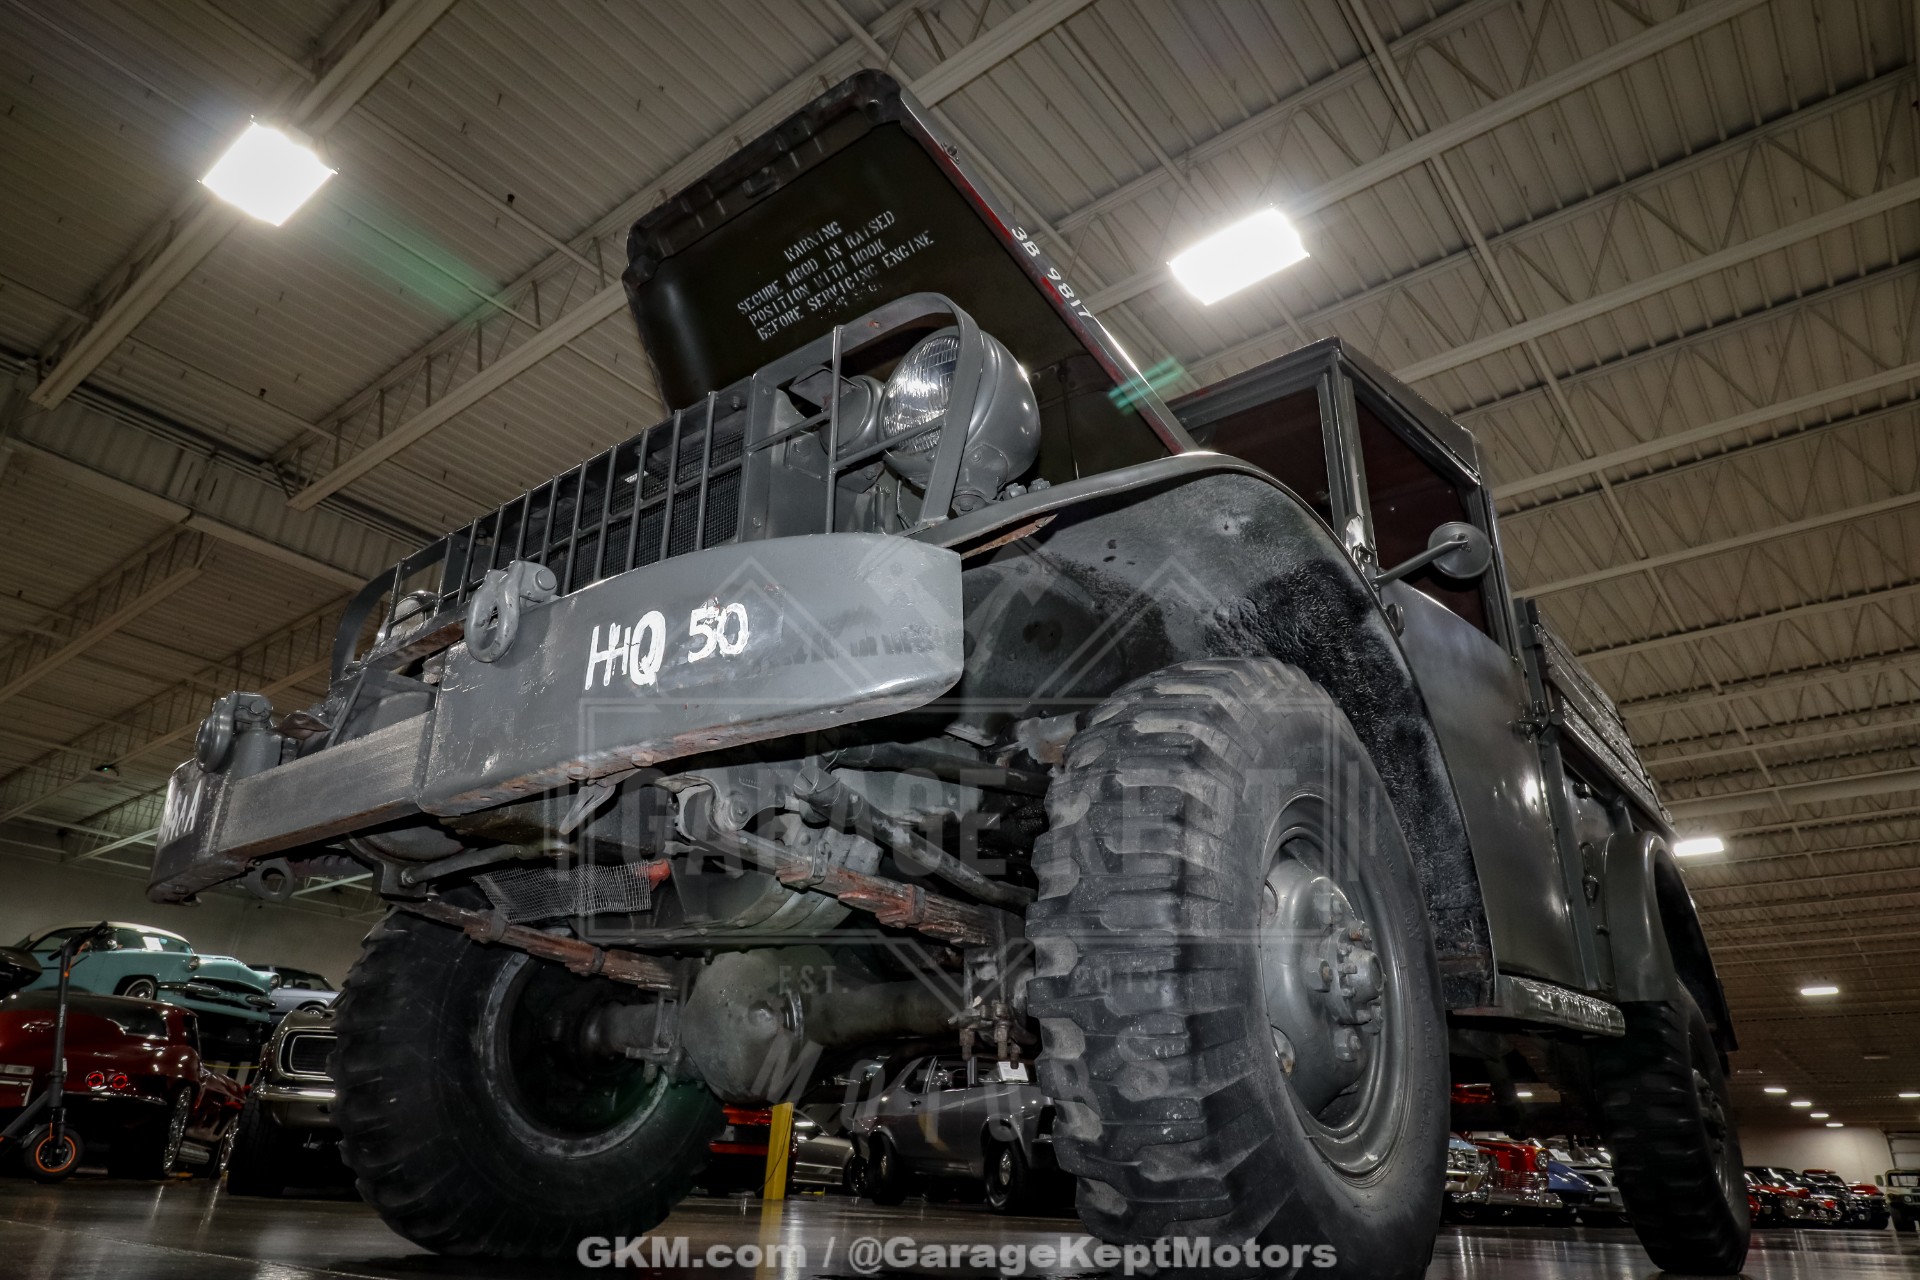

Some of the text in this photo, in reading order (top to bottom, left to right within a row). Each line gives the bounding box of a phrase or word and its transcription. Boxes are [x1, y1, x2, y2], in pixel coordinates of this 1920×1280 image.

[737, 279, 784, 316] SECURE
[785, 257, 819, 286] HOOD
[824, 243, 843, 262] IN
[844, 210, 896, 249] RAISED
[748, 282, 811, 328] POSITION
[813, 260, 848, 289] WITH
[850, 238, 887, 267] HOOK
[756, 305, 805, 343] BEFORE
[806, 263, 879, 313] SERVICING
[881, 229, 936, 269] ENGINE
[1011, 226, 1093, 319] 3B 9817
[687, 601, 750, 664] 50
